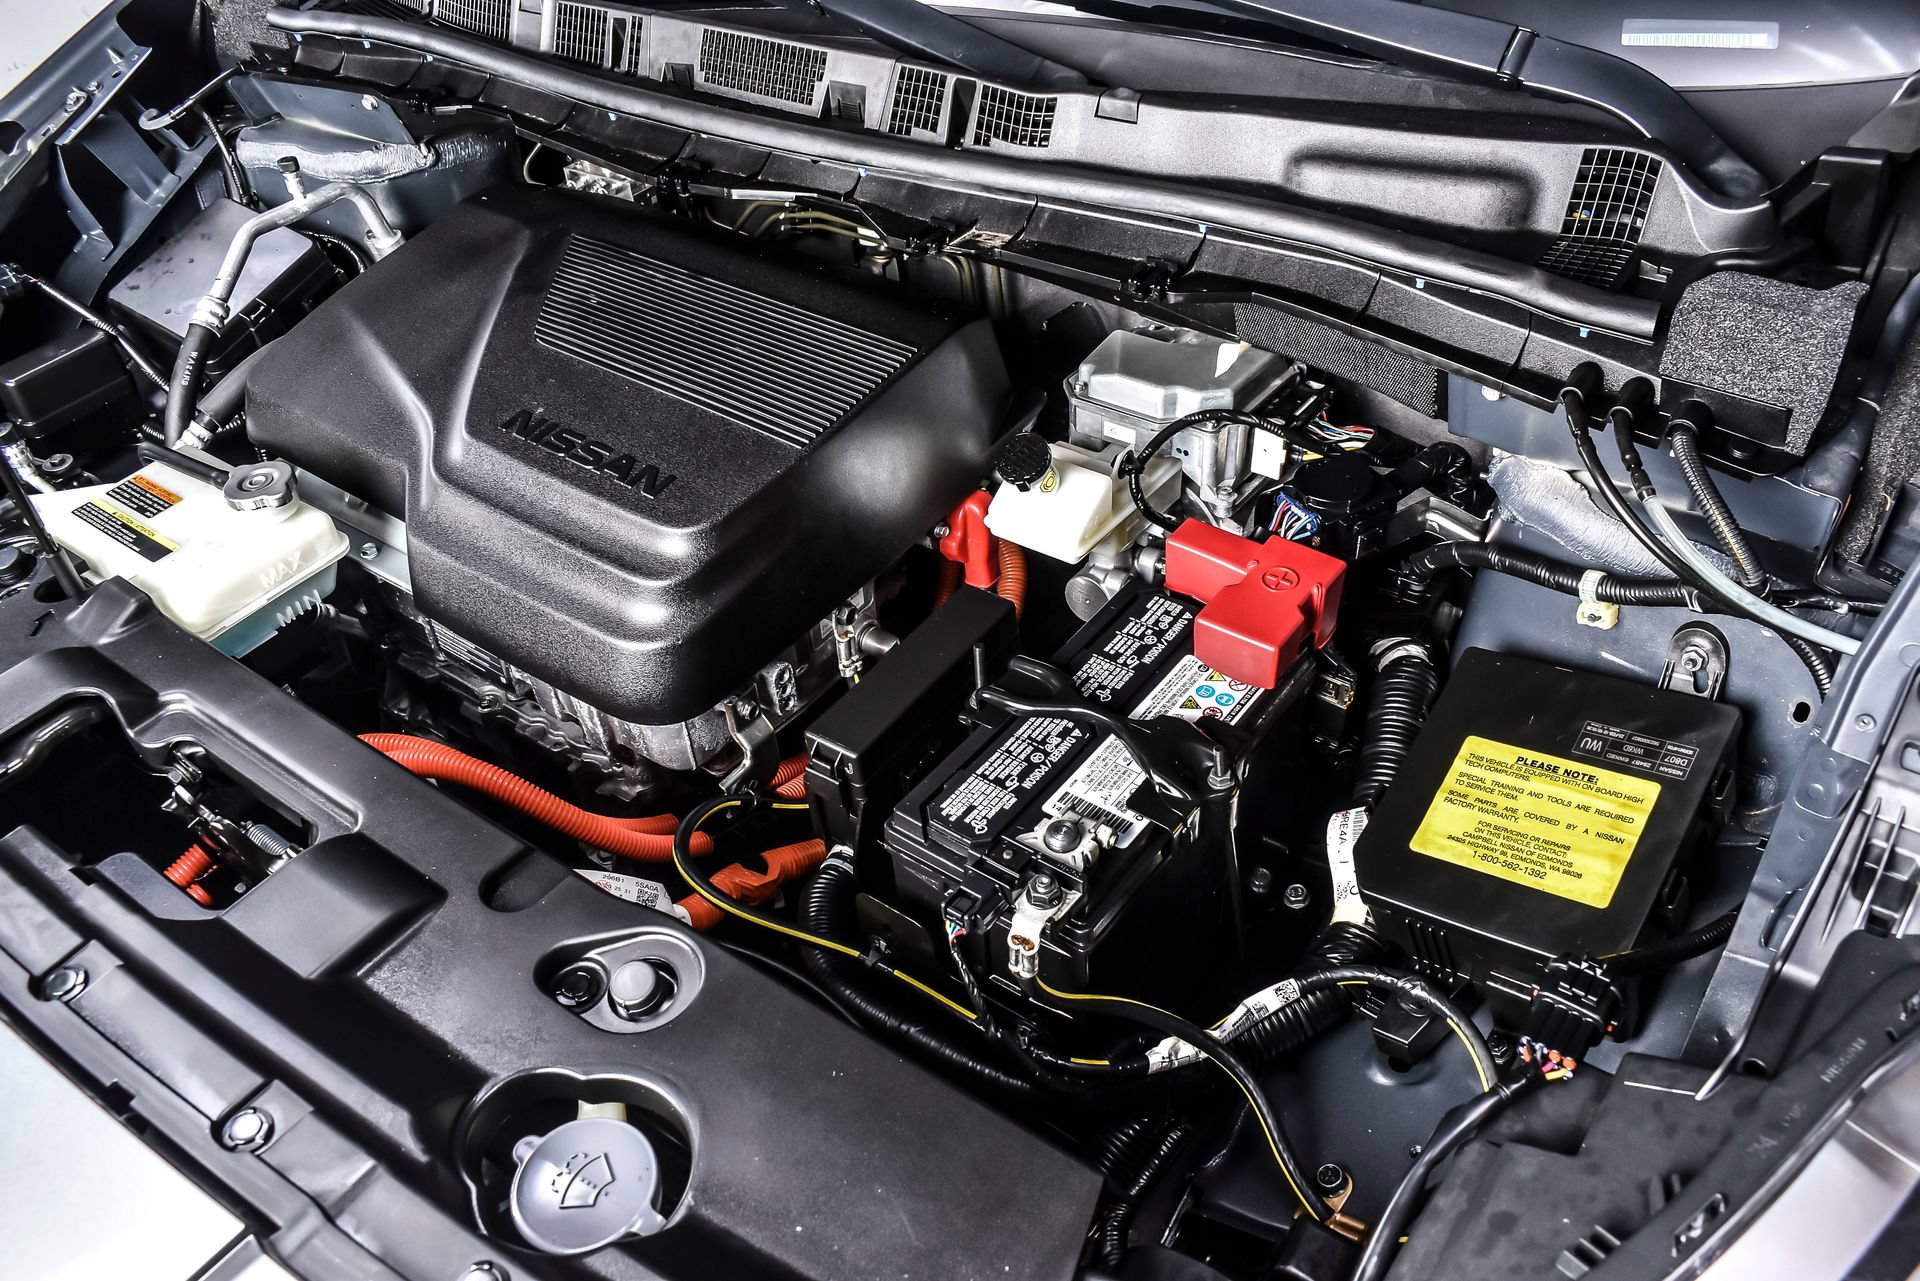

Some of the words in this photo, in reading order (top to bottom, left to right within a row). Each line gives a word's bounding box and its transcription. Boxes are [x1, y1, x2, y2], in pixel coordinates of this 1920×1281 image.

[498, 409, 679, 499] NISSAN
[259, 551, 307, 589] MAX
[276, 589, 322, 627] MIN
[1162, 618, 1188, 641] DANGER
[1140, 642, 1165, 664] POISON
[1047, 736, 1077, 762] DANGER
[1579, 737, 1602, 752] WU
[1464, 758, 1485, 769] TECH
[1483, 764, 1531, 782] COMPUTERS.
[1515, 755, 1561, 774] PLEASE
[1561, 768, 1599, 785] NOTE:
[1658, 765, 1683, 776] NISSAN
[1663, 755, 1688, 767] D807
[1020, 764, 1049, 789] POISON
[1454, 777, 1465, 786] TO
[1464, 781, 1496, 795] SERVICE
[1496, 789, 1519, 801] THEM.
[1468, 752, 1485, 762] THIS
[1485, 757, 1515, 770] VEHICLE
[1514, 765, 1524, 773] IS
[1522, 767, 1561, 782] EQUIPPED
[1561, 777, 1582, 788] WITH
[1581, 783, 1595, 791] ON
[1594, 786, 1623, 799] BOARD
[1622, 793, 1644, 804] HIGH
[1443, 795, 1478, 810] FACTORY
[1477, 805, 1520, 824] WARRANTY.
[1457, 771, 1487, 785] SPECIAL
[1490, 779, 1525, 795] TRAINING
[1526, 790, 1544, 800] AND
[1547, 794, 1572, 808] TOOLS
[1573, 803, 1592, 813] ARE
[1593, 807, 1635, 824] REQUIRED
[1447, 789, 1470, 800] SOME
[1473, 796, 1498, 809] PARTS
[1501, 805, 1519, 815] ARE
[1523, 811, 1560, 827] COVERED
[1565, 822, 1578, 831] BY
[1581, 827, 1589, 835] A
[1594, 831, 1625, 845] NISSAN
[1473, 826, 1486, 834] ON
[1486, 829, 1502, 840] THIS
[1502, 833, 1531, 849] VEHICLE,
[1476, 819, 1493, 829] FOR
[1492, 824, 1529, 840] SERVICING
[1528, 835, 1541, 843] OR
[1540, 838, 1571, 851] REPAIRS
[1461, 831, 1498, 847] CAMPBELL
[1498, 841, 1526, 854] NISSAN
[1525, 849, 1537, 857] OF
[1536, 852, 1574, 869] EDMONDS
[1466, 839, 1500, 854] HIGHWAY
[1509, 852, 1547, 870] EDMONDS,
[1548, 864, 1560, 873] WA
[1472, 850, 1547, 880] 1-800-562-1392
